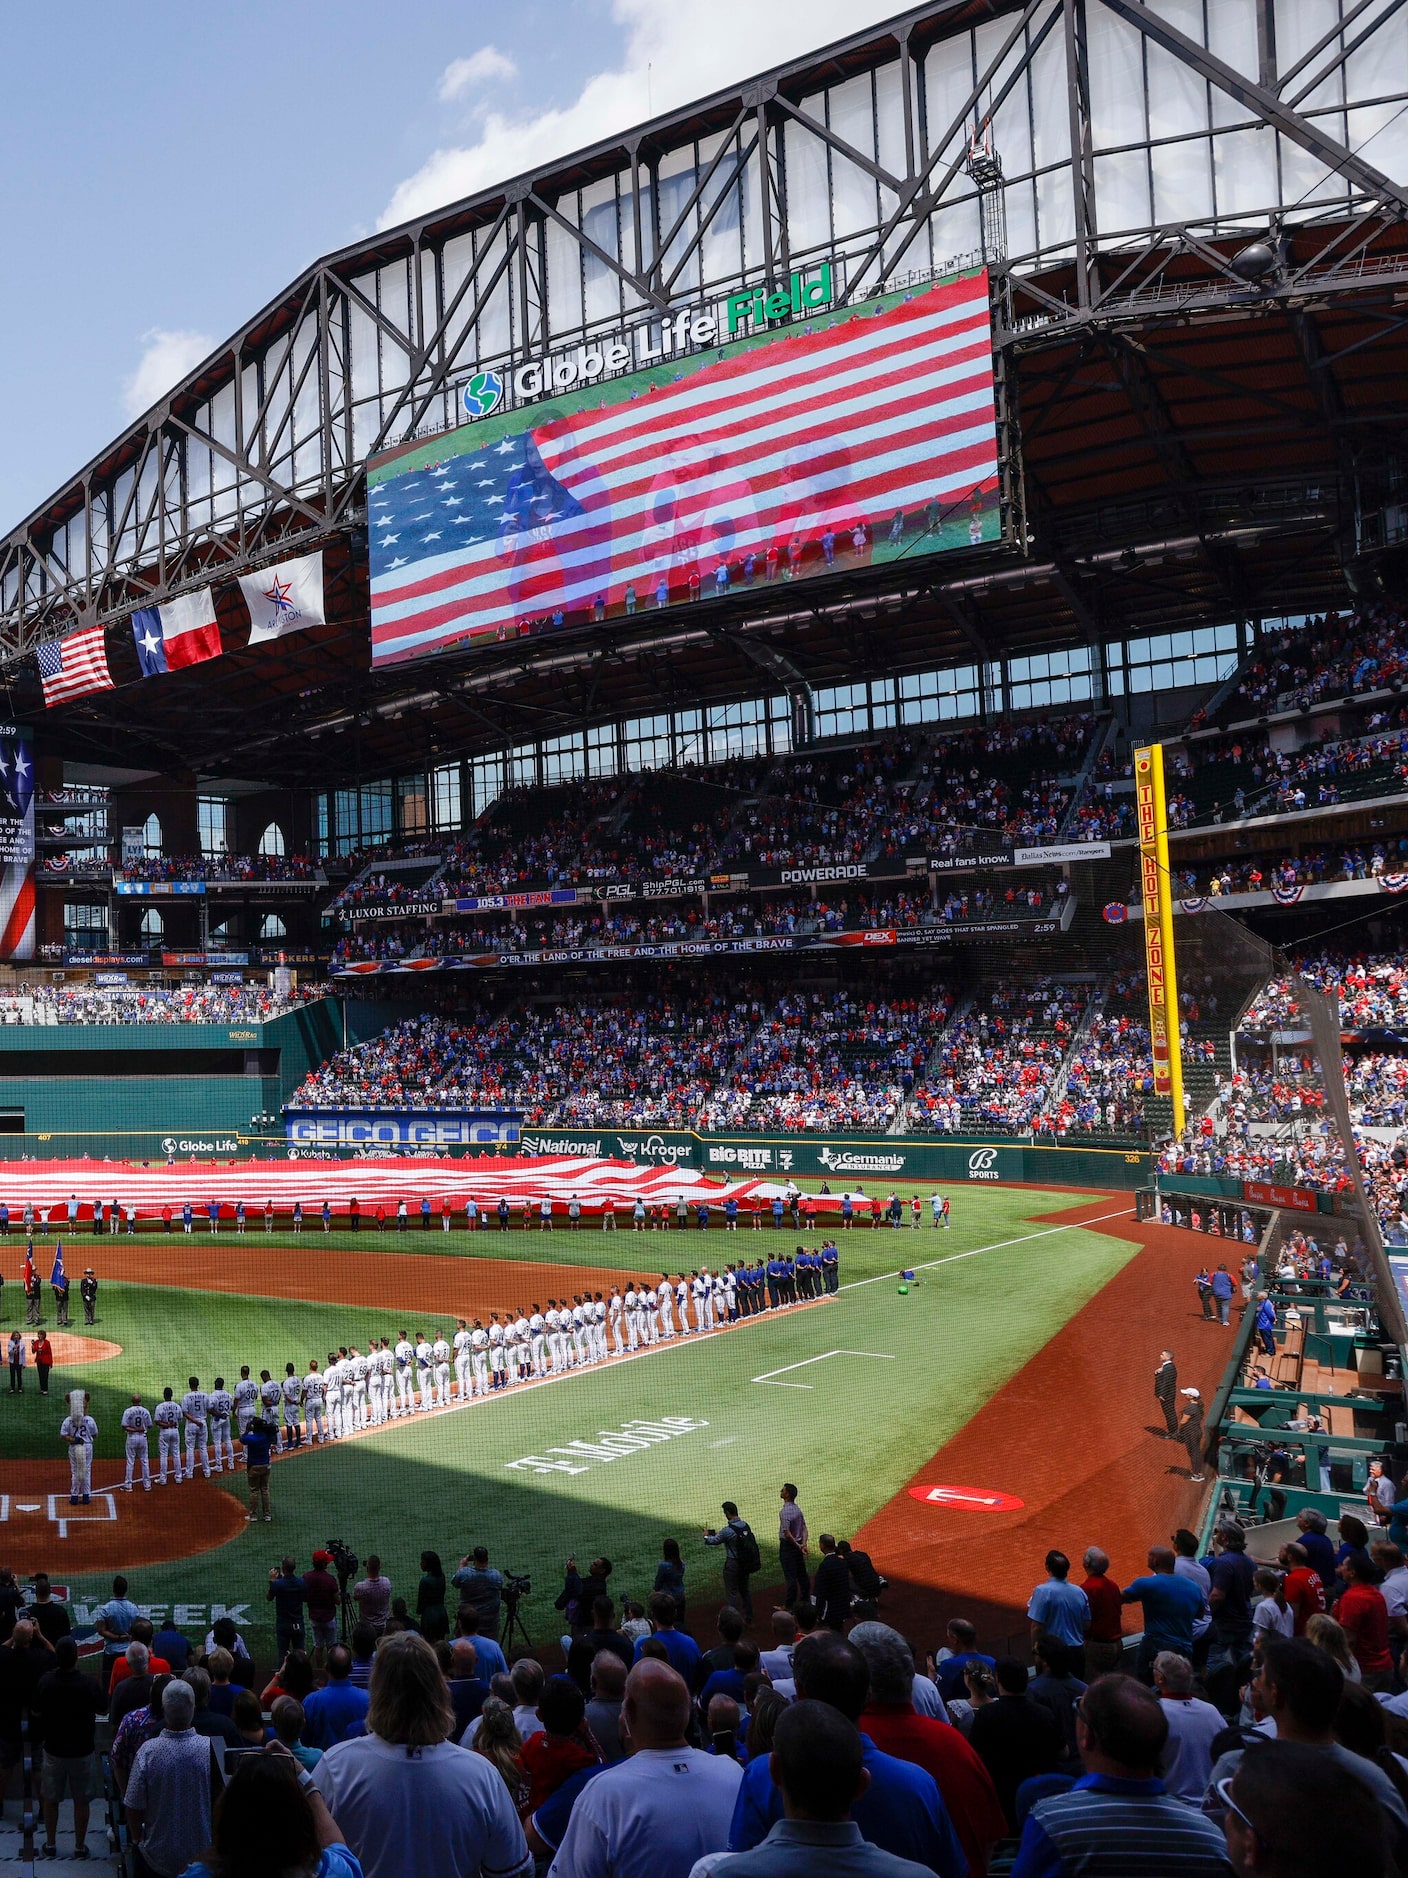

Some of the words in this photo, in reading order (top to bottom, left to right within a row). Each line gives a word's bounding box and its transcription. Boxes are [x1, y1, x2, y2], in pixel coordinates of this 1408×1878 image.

[513, 340, 630, 400] Globe
[638, 308, 718, 362] Life
[726, 262, 832, 334] Field
[1140, 786, 1153, 842] THE
[9, 837, 25, 845] AND
[3, 855, 28, 863] BRAVE
[930, 858, 954, 869] Real
[955, 857, 977, 867] fans
[979, 855, 1010, 866] know.
[781, 863, 868, 884] POWERADE
[606, 884, 637, 896] PGL
[1145, 857, 1159, 913] HOT
[476, 897, 504, 908] 105.3
[505, 895, 528, 906] THE
[529, 892, 552, 904] FAN
[349, 906, 385, 919] LUXOR
[387, 903, 439, 916] STAFFING
[1034, 924, 1055, 933] 2:59
[864, 932, 891, 941] DEX
[500, 955, 520, 964] O'ER
[522, 954, 540, 963] THE
[542, 952, 568, 962] LAND
[570, 951, 584, 960] OF
[587, 950, 605, 959] THE
[607, 948, 631, 958] FREE
[633, 947, 655, 956] AND
[659, 945, 678, 955] THE
[680, 943, 711, 953] HOME
[714, 942, 729, 951] OF
[732, 941, 752, 950] THE
[755, 938, 793, 949] BRAVE
[68, 955, 145, 967] dieseldisplays.com
[262, 955, 315, 963] PLUKERS
[1149, 929, 1163, 1005] ZONE
[291, 1119, 400, 1149] GEICO
[179, 1140, 214, 1151] Globe
[216, 1139, 237, 1151] Life
[641, 1135, 692, 1165] Kroger
[737, 1149, 771, 1162] BITE
[842, 1152, 905, 1165] Germania
[1125, 1155, 1140, 1163] 326
[743, 1162, 766, 1170] PIZZA
[969, 1171, 999, 1179] SPORTS
